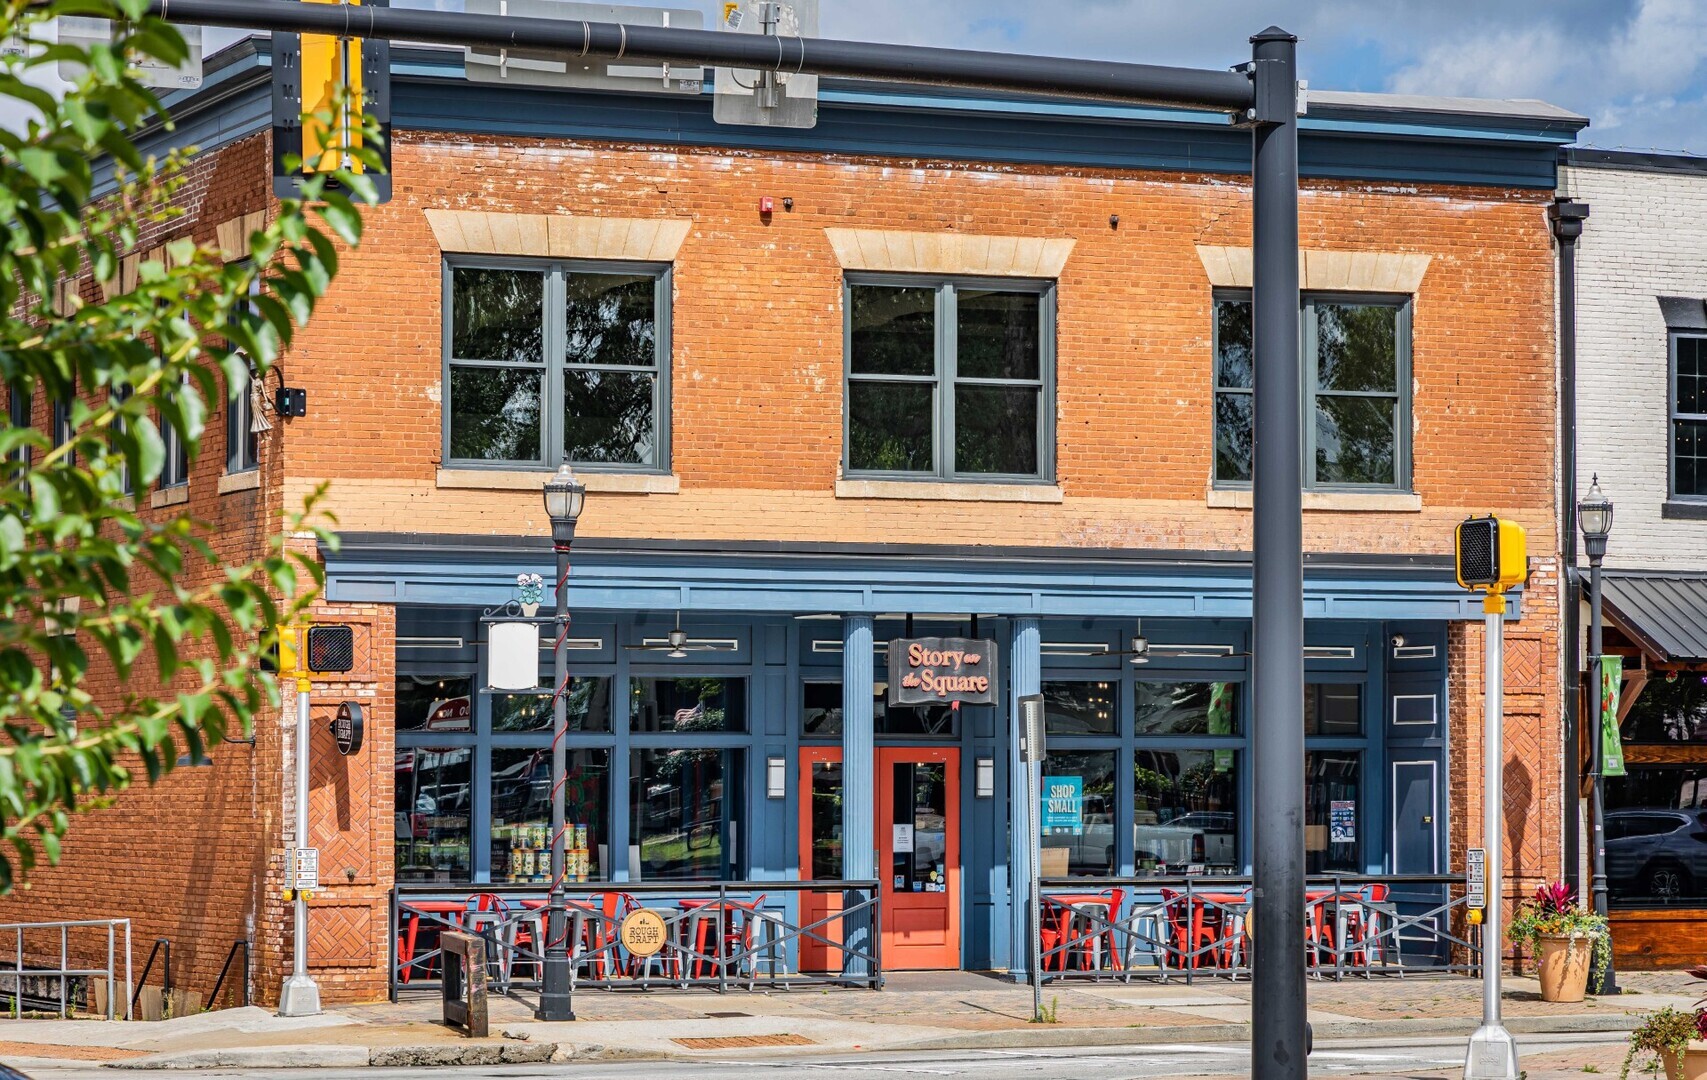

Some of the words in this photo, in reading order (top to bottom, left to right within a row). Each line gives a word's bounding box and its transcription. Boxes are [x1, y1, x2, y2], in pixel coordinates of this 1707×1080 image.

[908, 643, 965, 671] Story
[963, 653, 982, 664] on
[902, 672, 921, 688] the
[921, 669, 989, 697] Square
[1050, 784, 1076, 799] SHOP
[1047, 799, 1078, 813] SMALL
[629, 926, 659, 936] ROUGH
[629, 935, 659, 944] DRAFT
